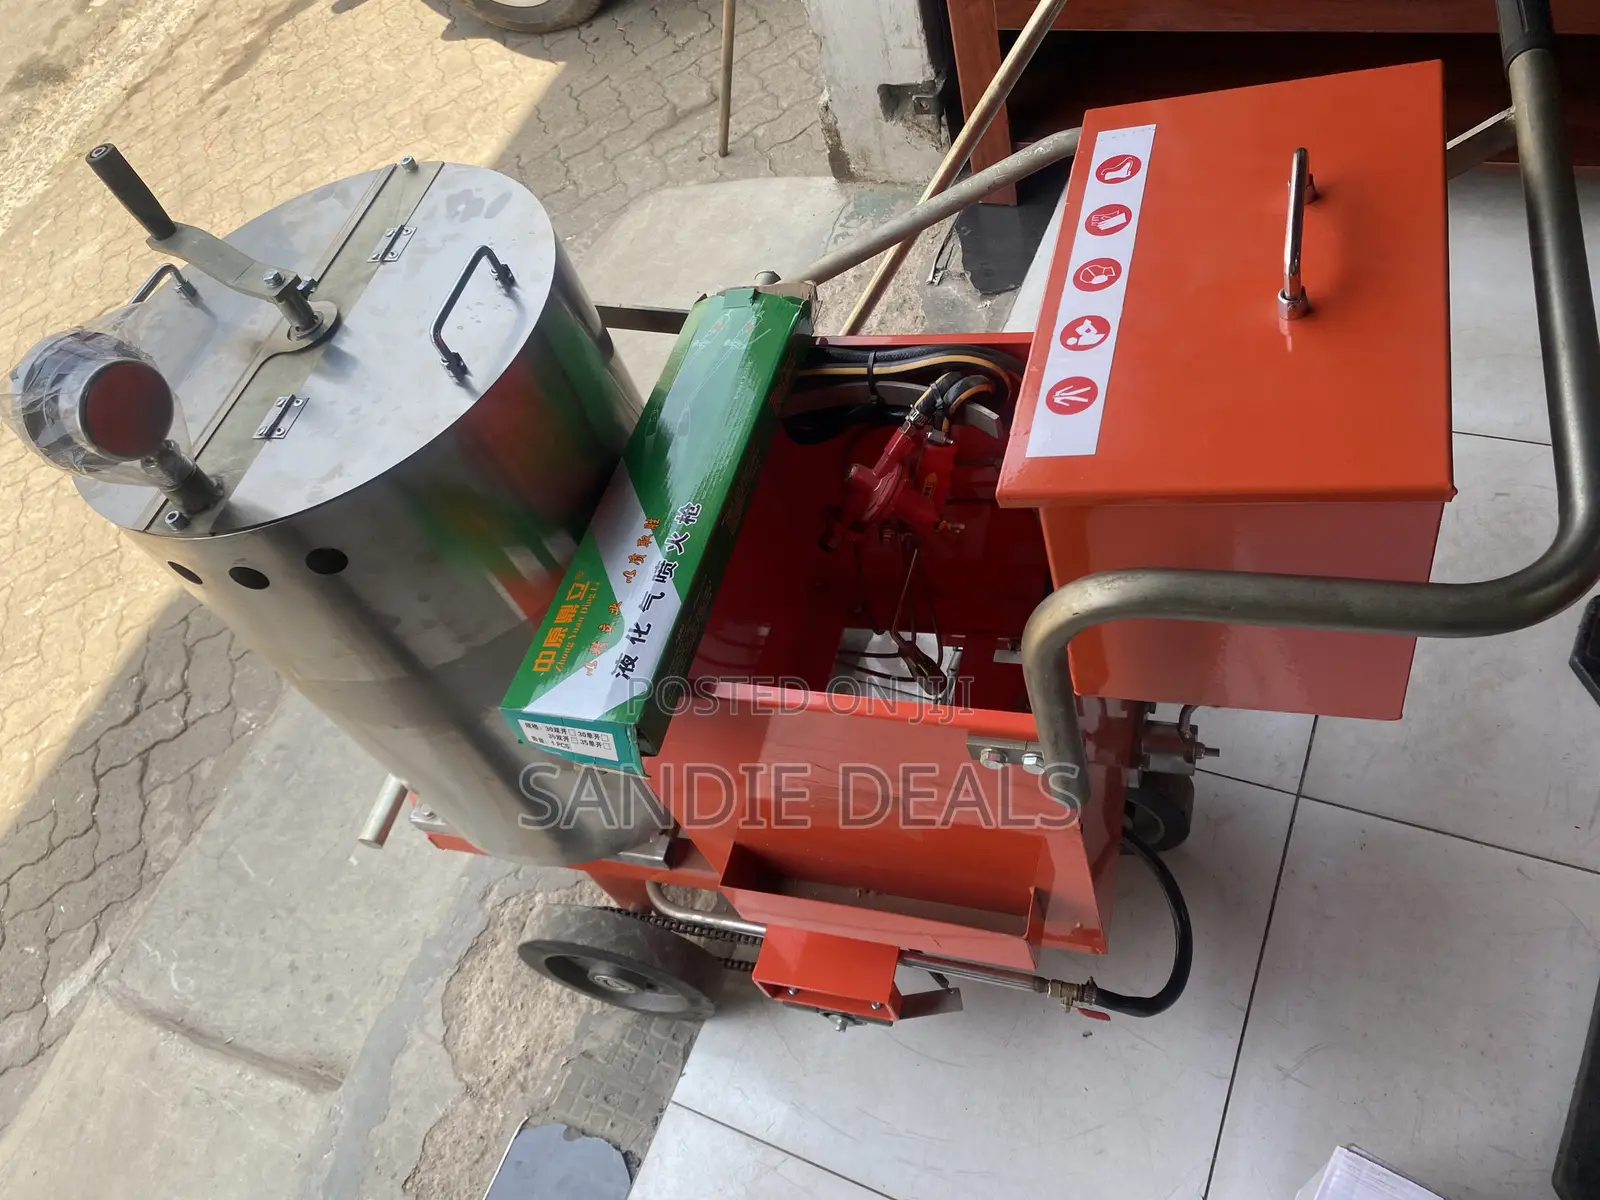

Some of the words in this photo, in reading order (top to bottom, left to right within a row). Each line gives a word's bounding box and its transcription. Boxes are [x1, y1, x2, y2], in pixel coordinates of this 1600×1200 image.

[533, 580, 590, 672] 中原鼎立
[611, 502, 701, 680] 液化气喷火枪
